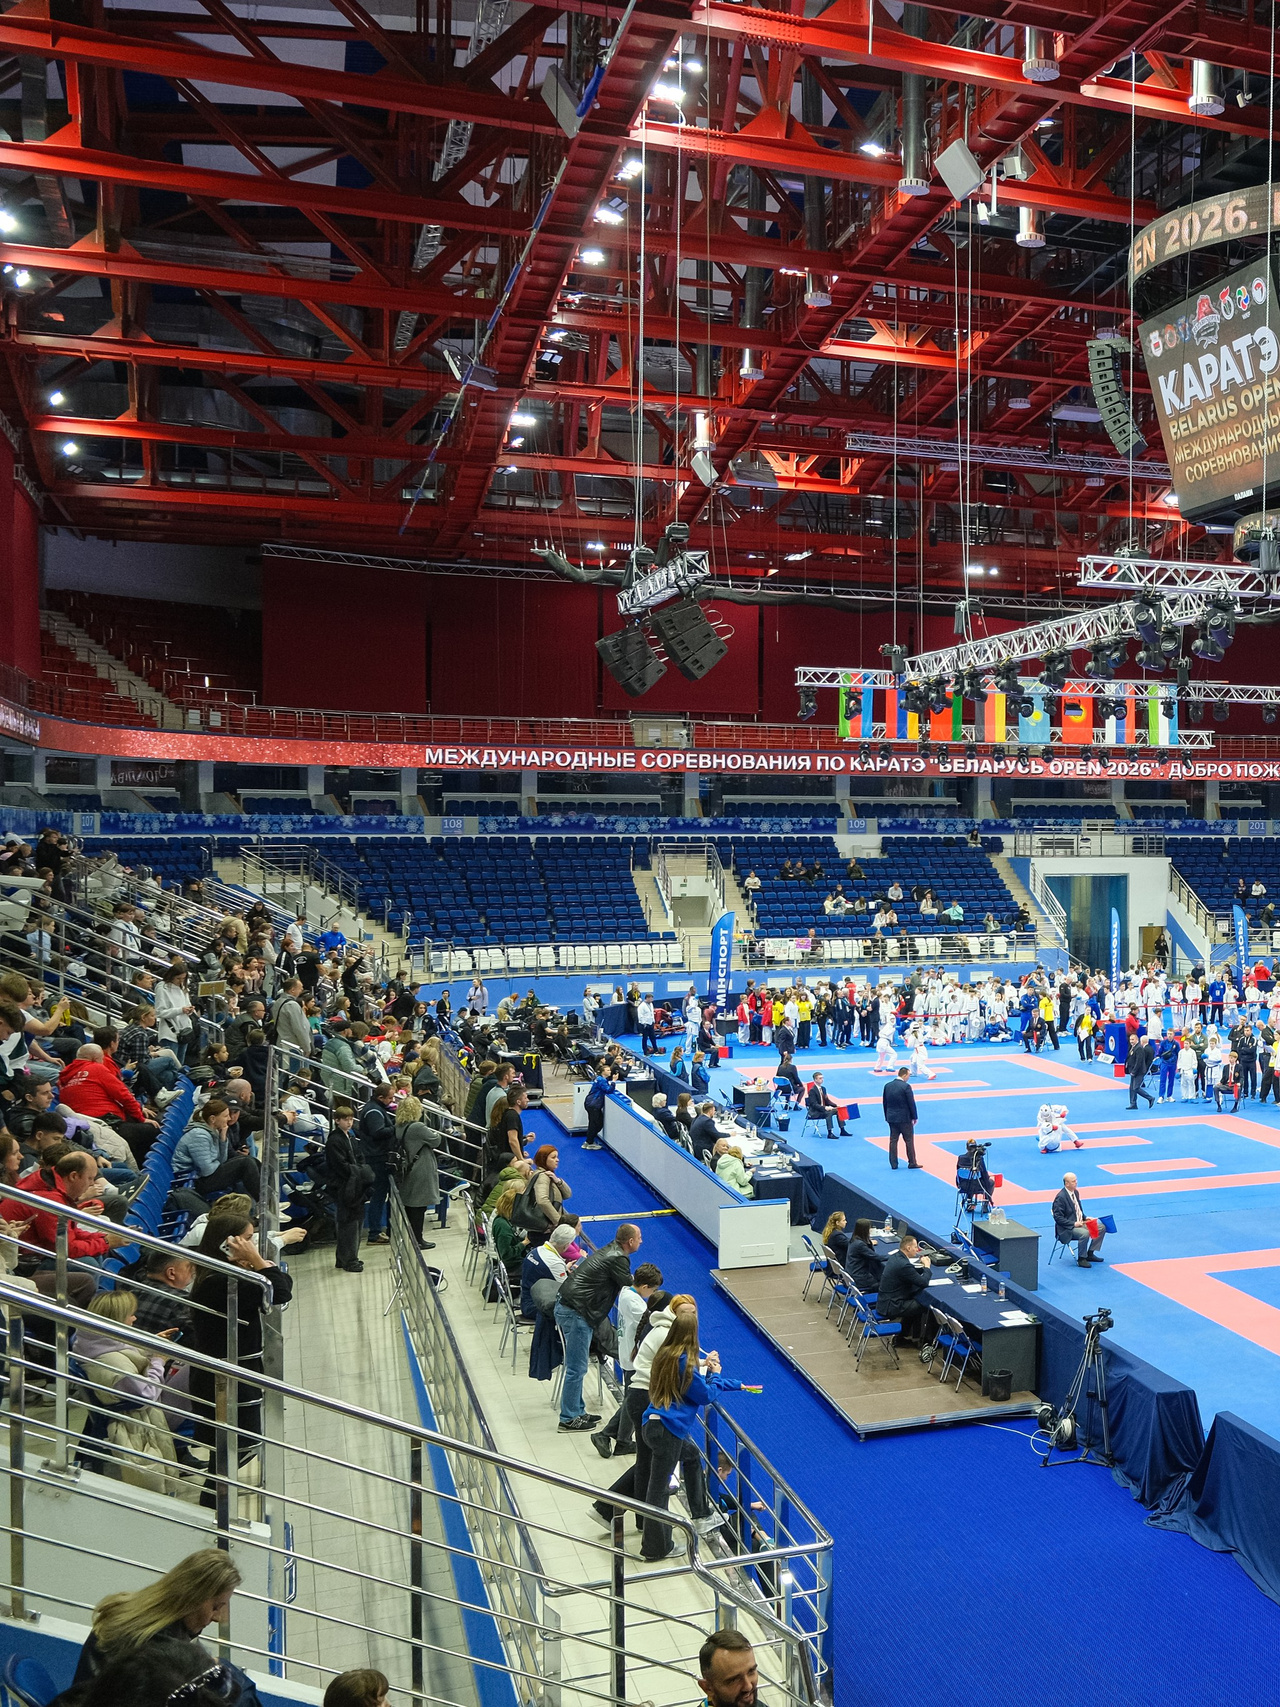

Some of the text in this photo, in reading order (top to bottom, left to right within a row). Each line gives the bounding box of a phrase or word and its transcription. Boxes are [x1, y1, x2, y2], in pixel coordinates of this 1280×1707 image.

[1164, 198, 1258, 255] 2026.
[1158, 325, 1280, 418] КАРАТЭ
[1169, 394, 1238, 441] BELARUS
[425, 747, 636, 769] МЕЖДУНАРОДНЫЕ
[641, 752, 811, 771] СОРЕВНОВАНИЯ
[816, 755, 845, 771] ПО
[850, 756, 926, 774] КАРАТЭ
[930, 757, 1044, 776] "БЕЛАРУСЬ
[1050, 760, 1101, 776] OPEN
[1169, 763, 1234, 780] ДОБРО
[82, 815, 94, 827] 107
[443, 819, 463, 829] 108
[849, 819, 866, 829] 109
[1249, 821, 1265, 830] 201
